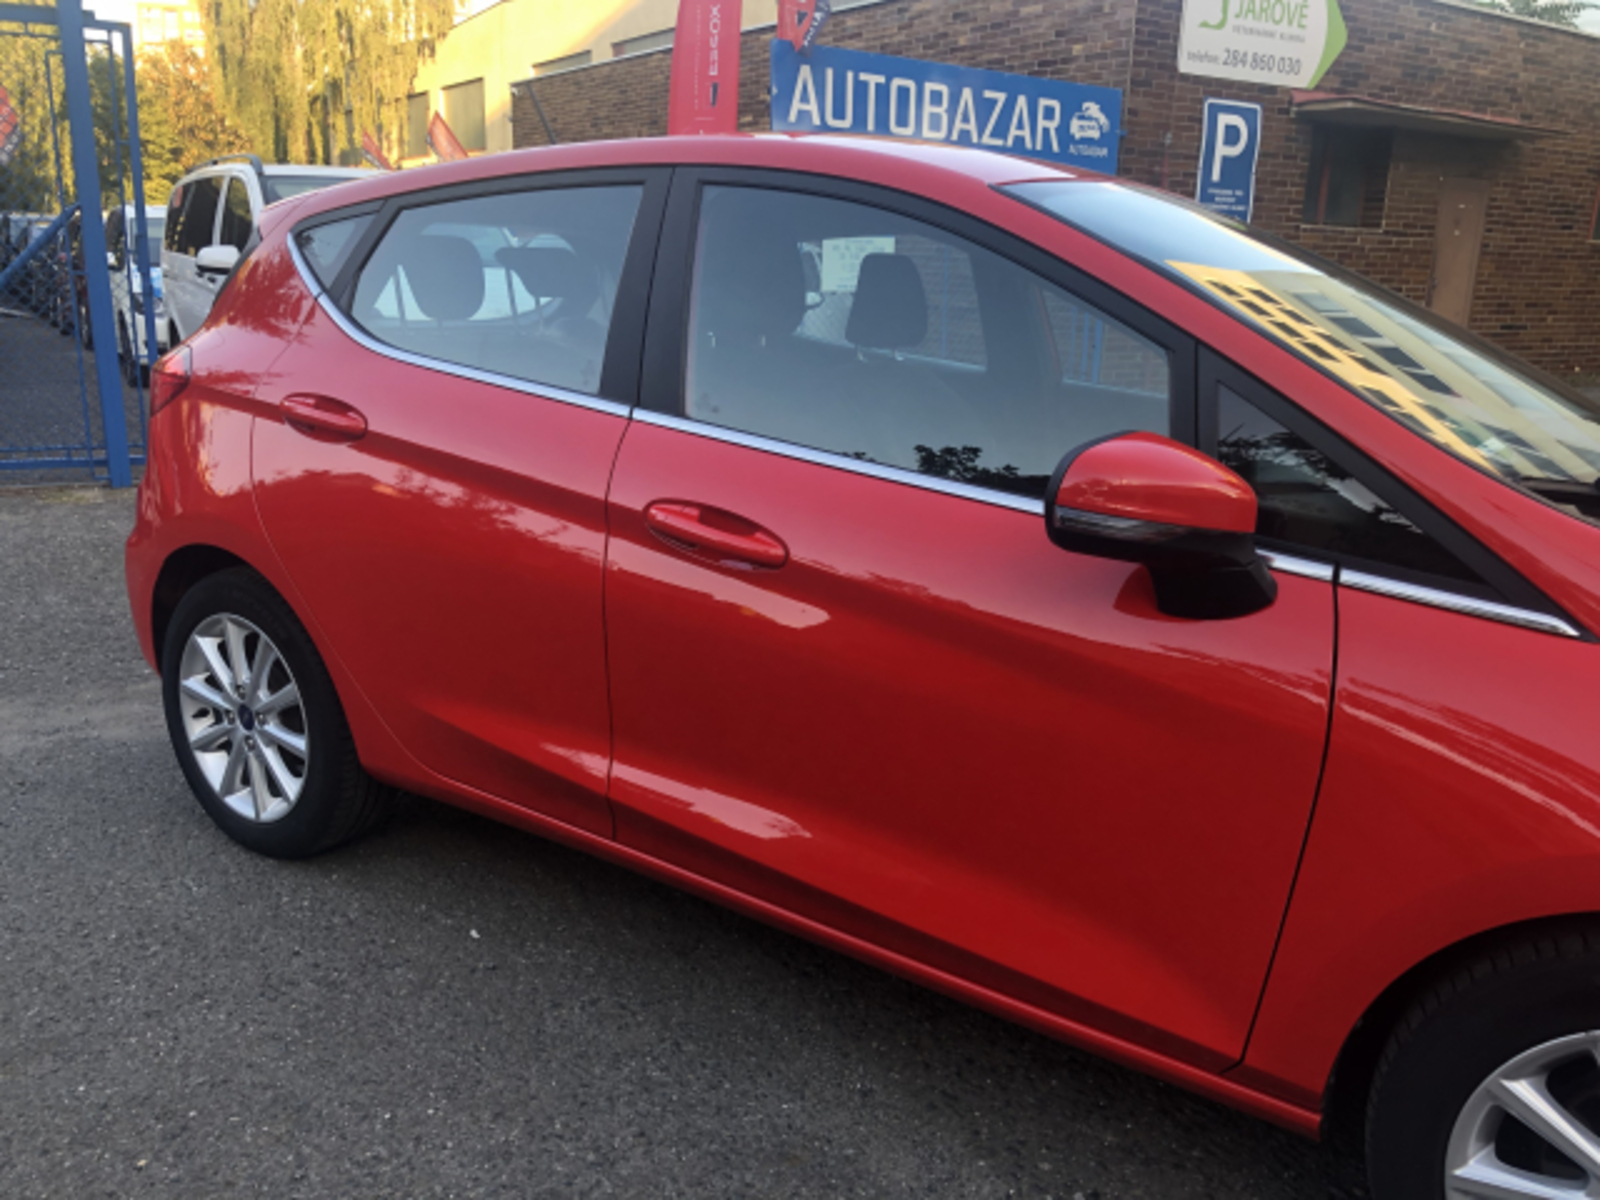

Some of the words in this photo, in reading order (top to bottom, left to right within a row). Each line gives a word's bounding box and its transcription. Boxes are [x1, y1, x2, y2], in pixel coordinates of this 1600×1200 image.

[1222, 47, 1248, 68] 284
[1250, 52, 1276, 72] 860
[1277, 56, 1302, 76] 030
[788, 65, 1061, 152] AUTOBAZAR
[1212, 113, 1248, 182] P
